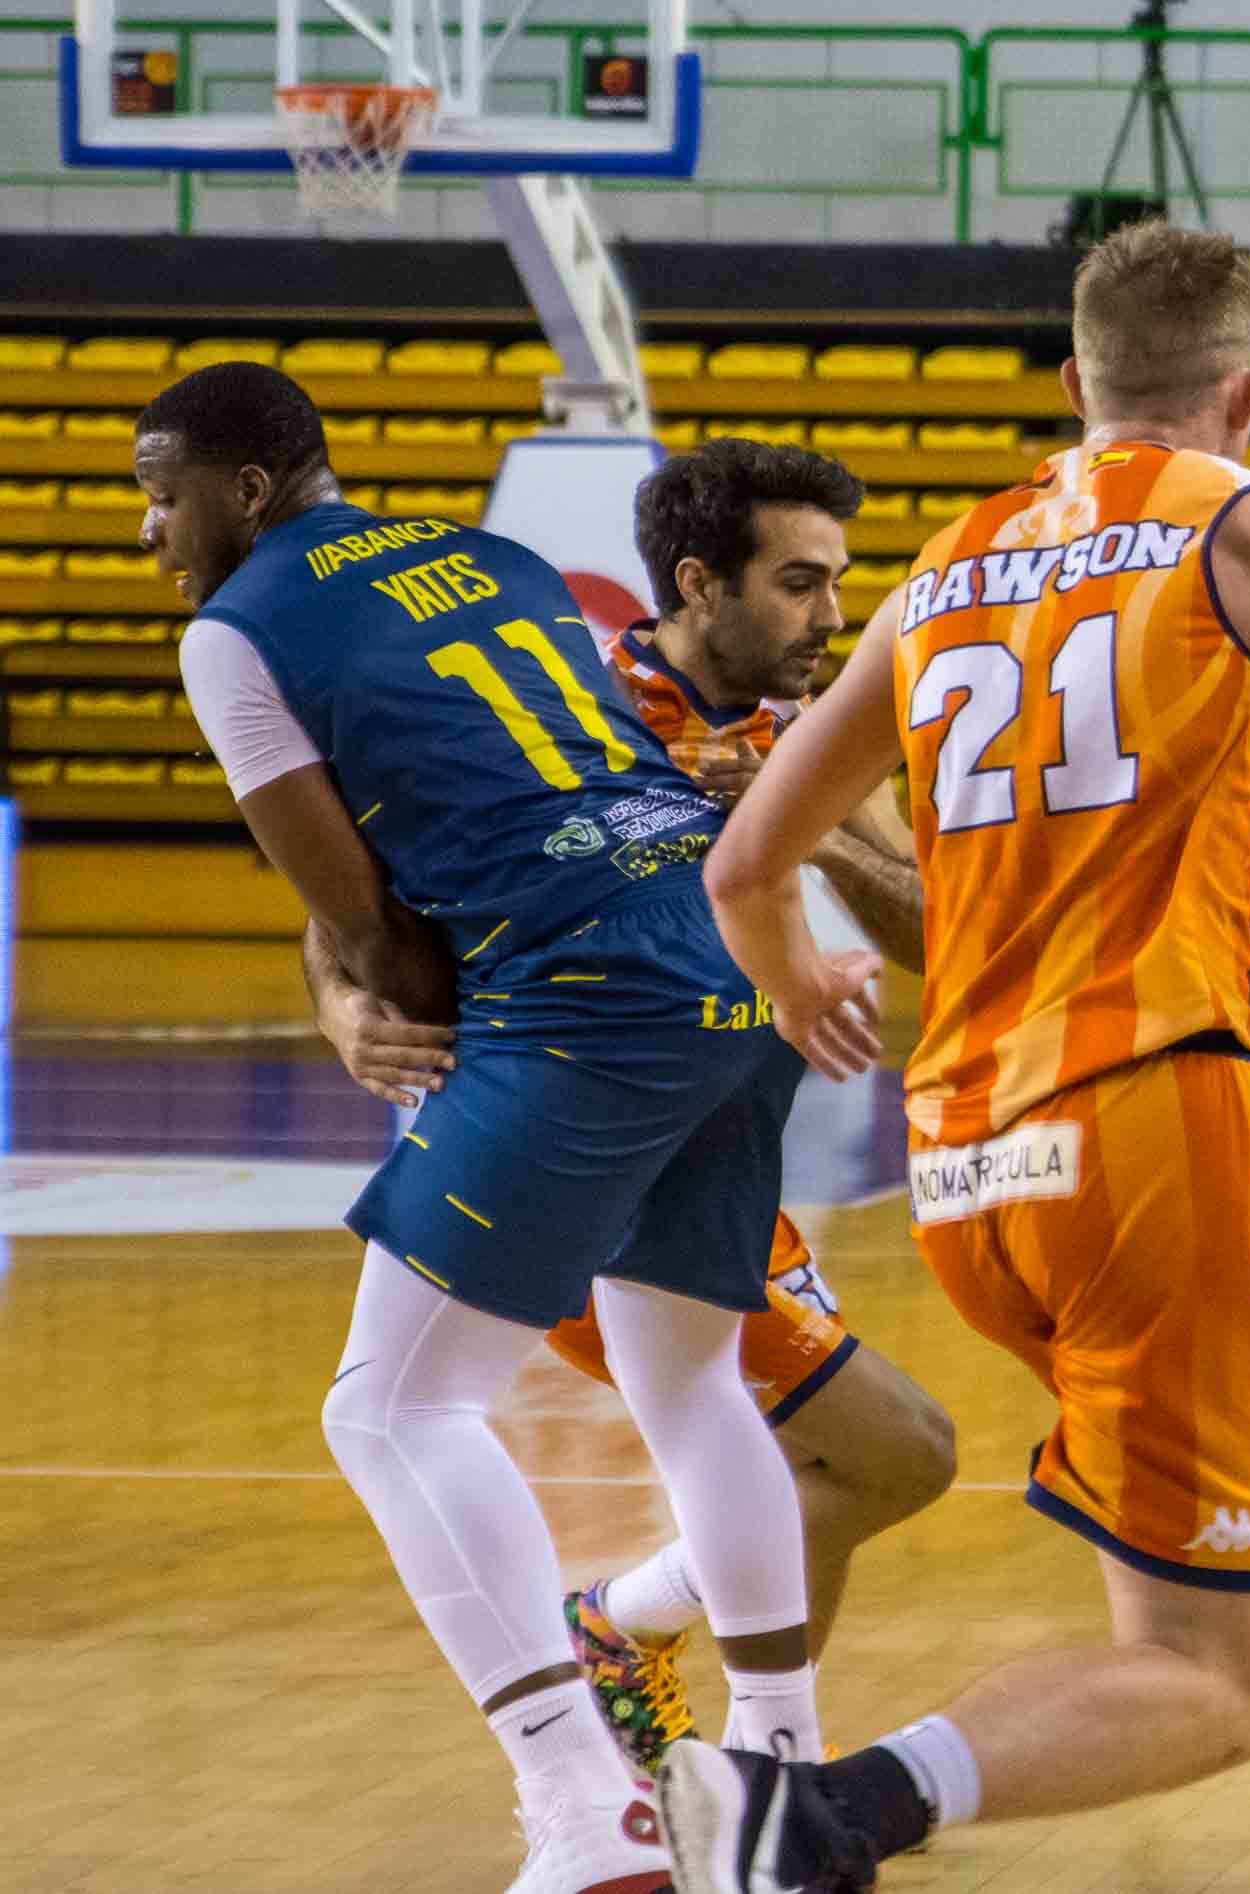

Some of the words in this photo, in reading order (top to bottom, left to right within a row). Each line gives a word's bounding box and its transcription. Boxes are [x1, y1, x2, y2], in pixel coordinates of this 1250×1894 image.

[370, 552, 501, 624] YATES
[901, 519, 1197, 637] RAWSON
[424, 618, 637, 792] 11
[909, 610, 1140, 834] 21
[696, 990, 776, 1030] Lak
